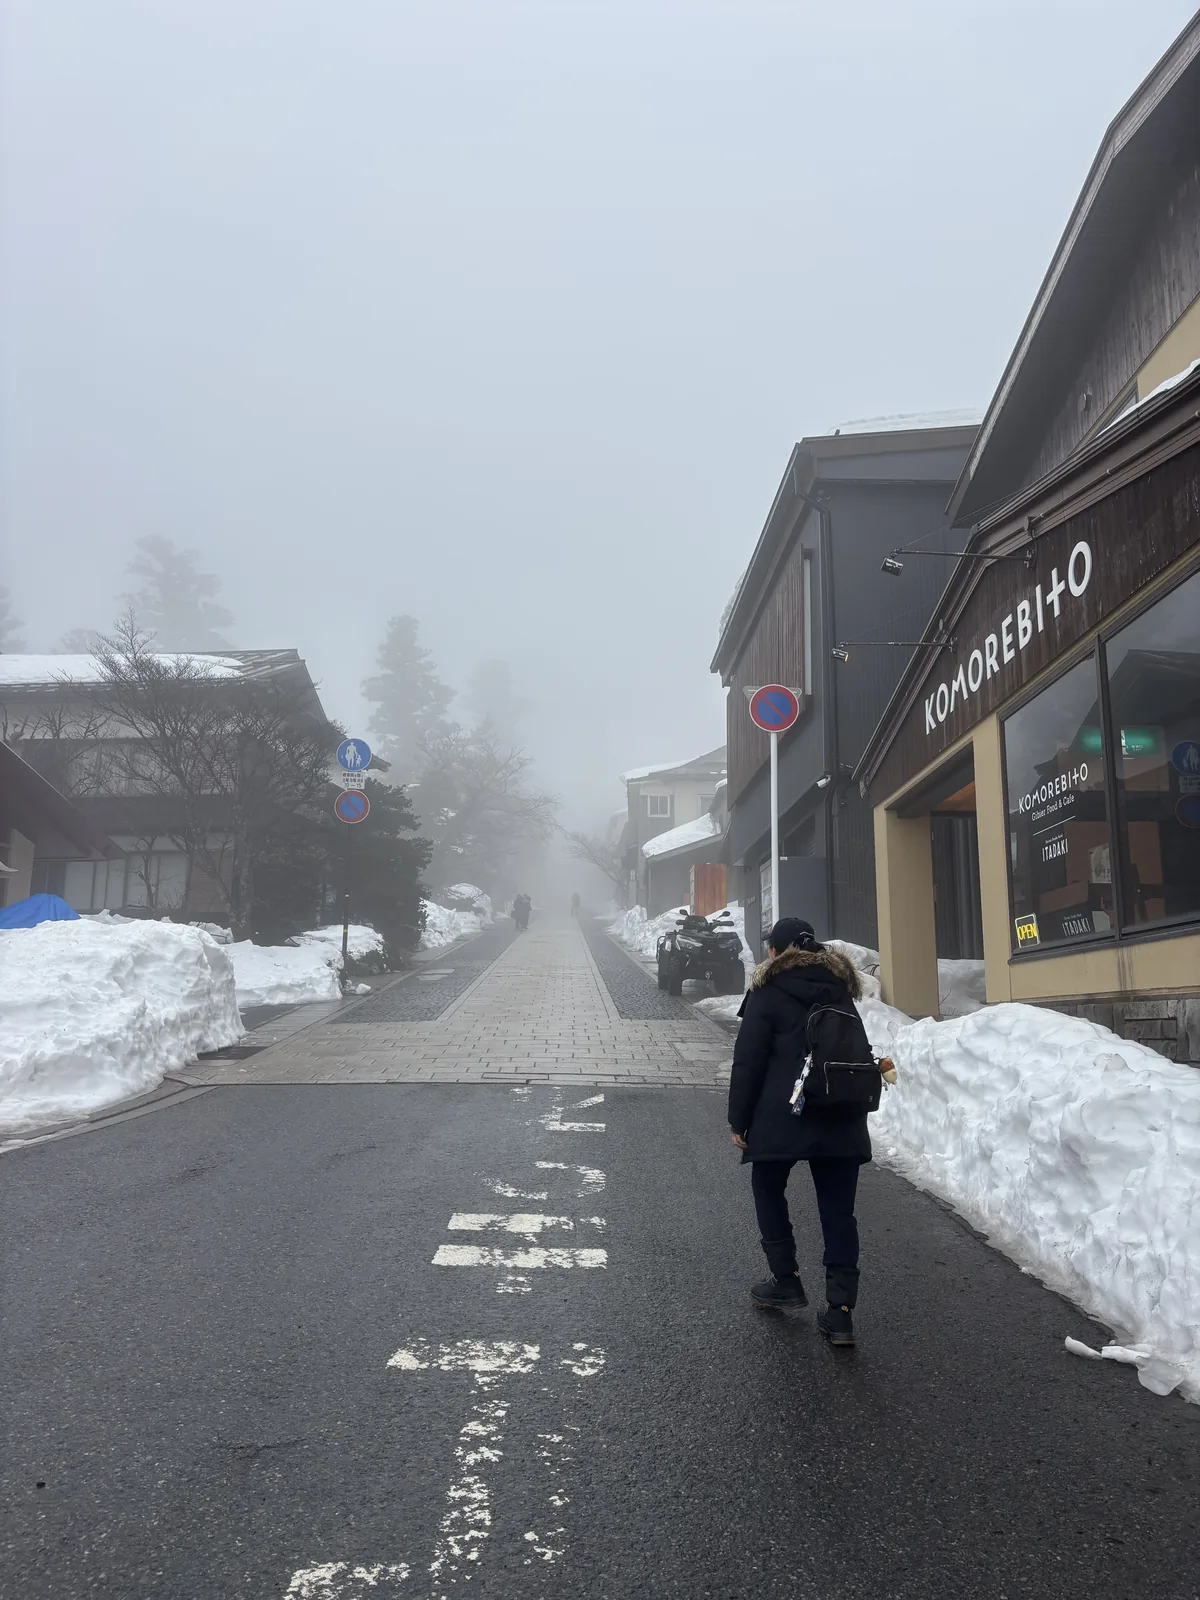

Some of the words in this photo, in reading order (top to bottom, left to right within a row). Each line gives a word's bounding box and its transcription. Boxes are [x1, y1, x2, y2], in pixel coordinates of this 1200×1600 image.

[1046, 801, 1058, 815] Food
[1058, 799, 1063, 809] &
[1042, 838, 1069, 862] ITADAKI
[1017, 922, 1038, 941] OPEN
[1061, 917, 1091, 937] ITADAKI
